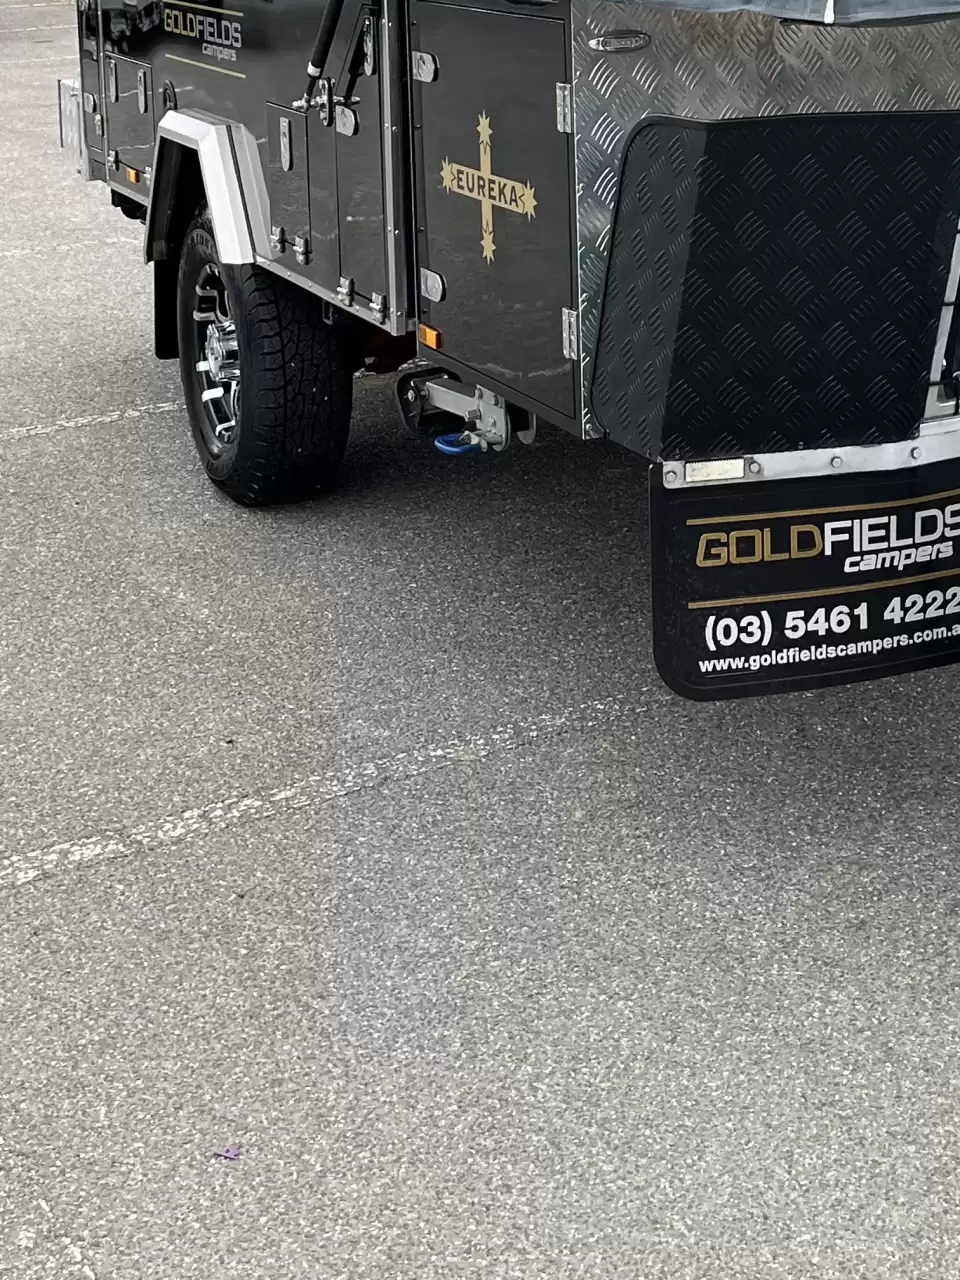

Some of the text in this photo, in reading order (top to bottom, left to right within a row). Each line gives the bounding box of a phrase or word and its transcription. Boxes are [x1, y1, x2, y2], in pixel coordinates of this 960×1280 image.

[164, 8, 242, 48] GOLDFIELDS
[202, 42, 237, 61] campers
[456, 168, 519, 208] EUREKA
[844, 540, 954, 573] campers
[704, 610, 772, 651] (03)
[784, 602, 868, 639] 5461
